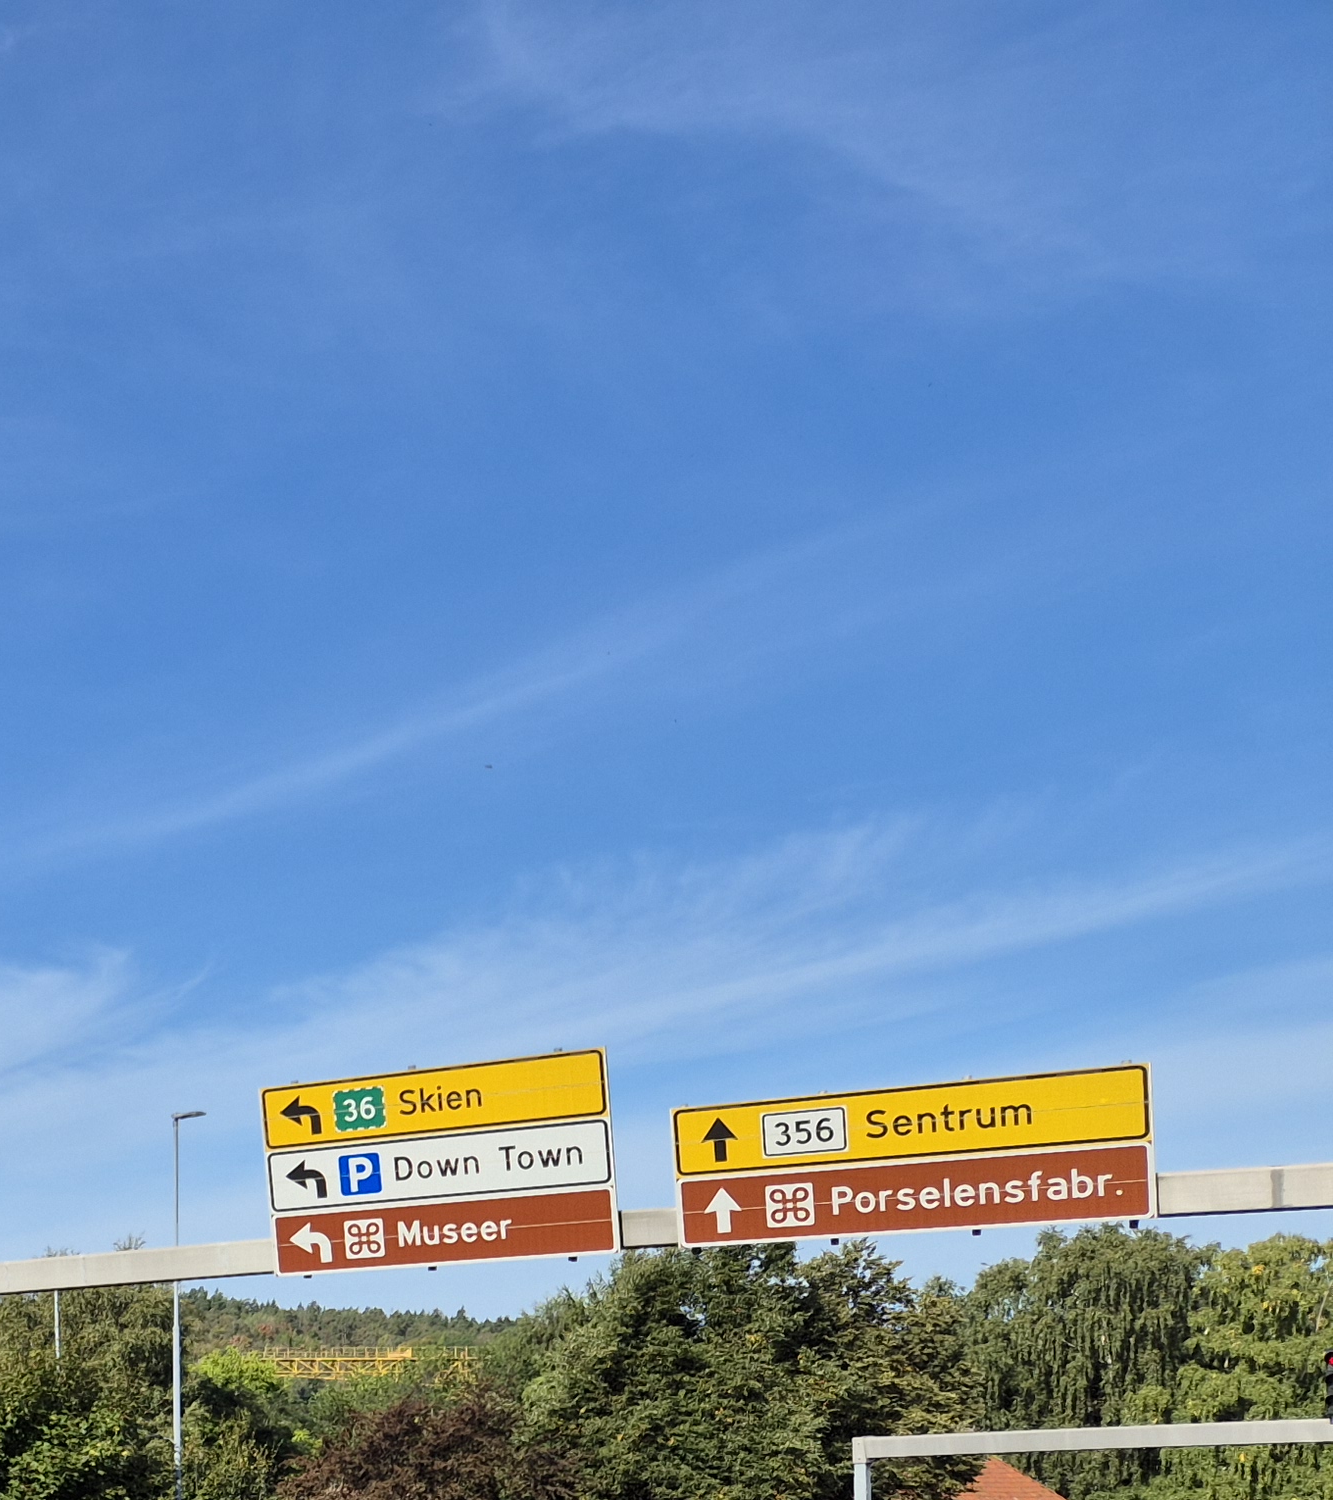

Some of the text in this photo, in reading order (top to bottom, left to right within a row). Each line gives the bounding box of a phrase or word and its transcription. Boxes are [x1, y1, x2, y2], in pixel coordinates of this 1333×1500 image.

[341, 1085, 483, 1122] 36 Skien
[774, 1102, 1033, 1146] 356 Sentrum
[348, 1145, 584, 1192] P Down Town
[831, 1169, 1125, 1216] Porselensfabr.
[396, 1218, 512, 1248] Museer
